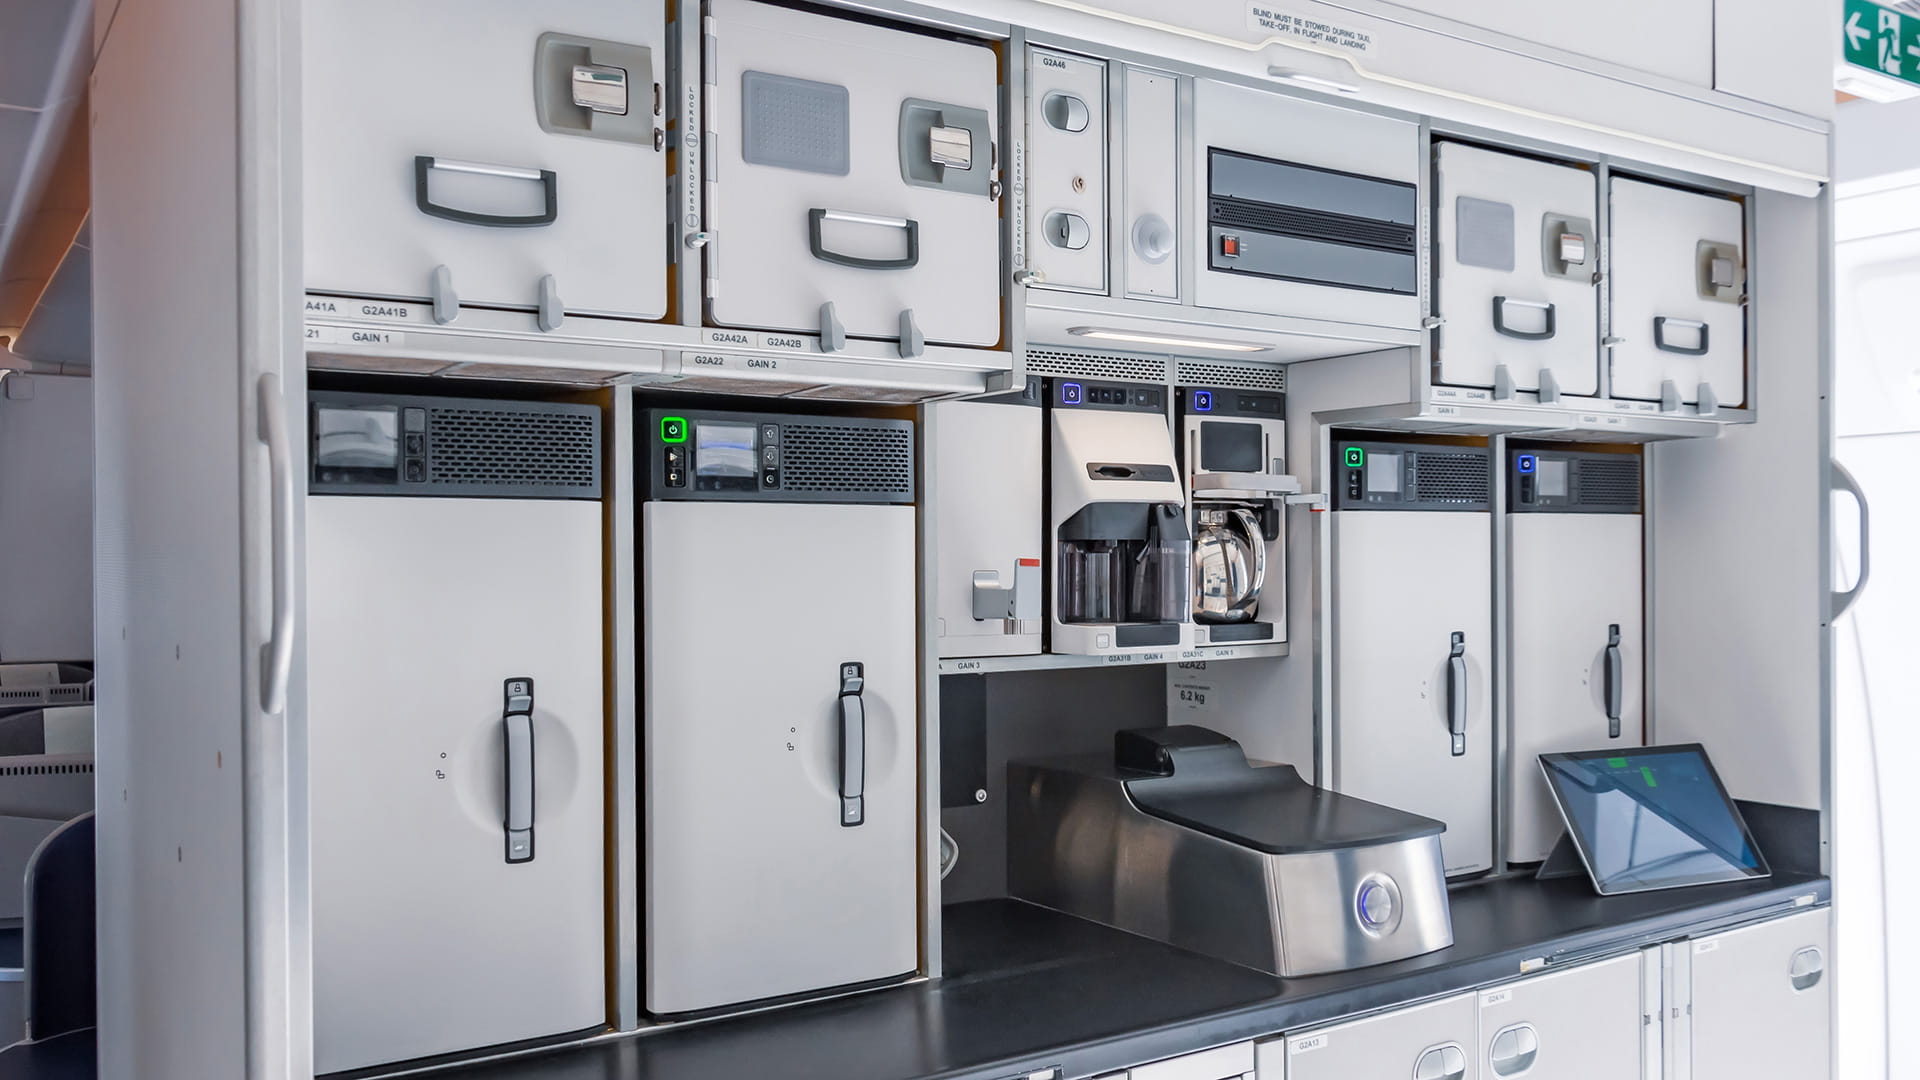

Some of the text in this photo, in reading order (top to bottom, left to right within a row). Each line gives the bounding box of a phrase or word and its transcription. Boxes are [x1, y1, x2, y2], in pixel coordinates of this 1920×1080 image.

[1252, 7, 1272, 18] BLIND
[1274, 12, 1292, 23] MUST
[1294, 17, 1302, 27] BE
[1305, 20, 1331, 33] STOWED
[1332, 28, 1355, 39] DURING
[1294, 27, 1301, 35] IN
[1302, 29, 1324, 40] FLIGHT
[1325, 34, 1338, 44] AND
[1340, 38, 1366, 51] LANDING
[1043, 57, 1066, 69] G2A46
[361, 305, 407, 318] G2A41B
[352, 332, 390, 343] GAIN 1
[712, 332, 748, 344] G2A42A
[767, 337, 802, 348] G2A42B
[694, 355, 724, 366] G2A22
[747, 359, 777, 369] GAIN 2
[957, 661, 981, 670] GAIN 3
[1180, 690, 1206, 704] 6.2 kg
